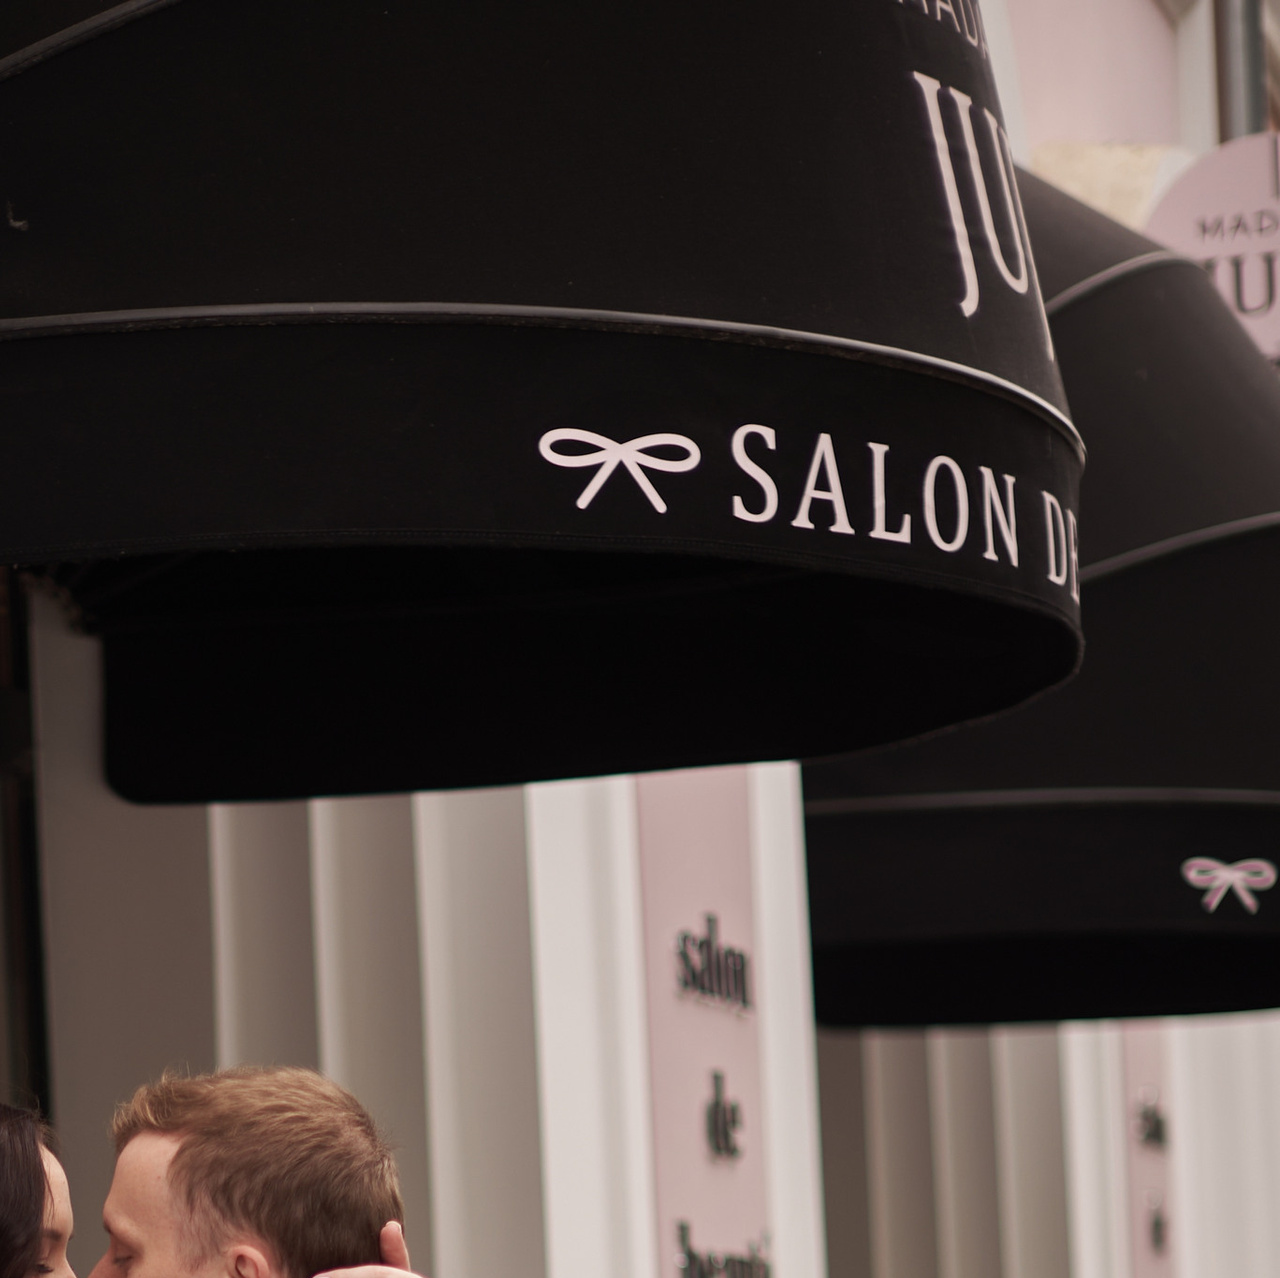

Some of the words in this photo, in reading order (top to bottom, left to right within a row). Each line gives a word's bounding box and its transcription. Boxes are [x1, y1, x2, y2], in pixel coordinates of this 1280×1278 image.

[913, 69, 1038, 322] JU
[1202, 250, 1279, 316] U
[731, 423, 1019, 568] SALON
